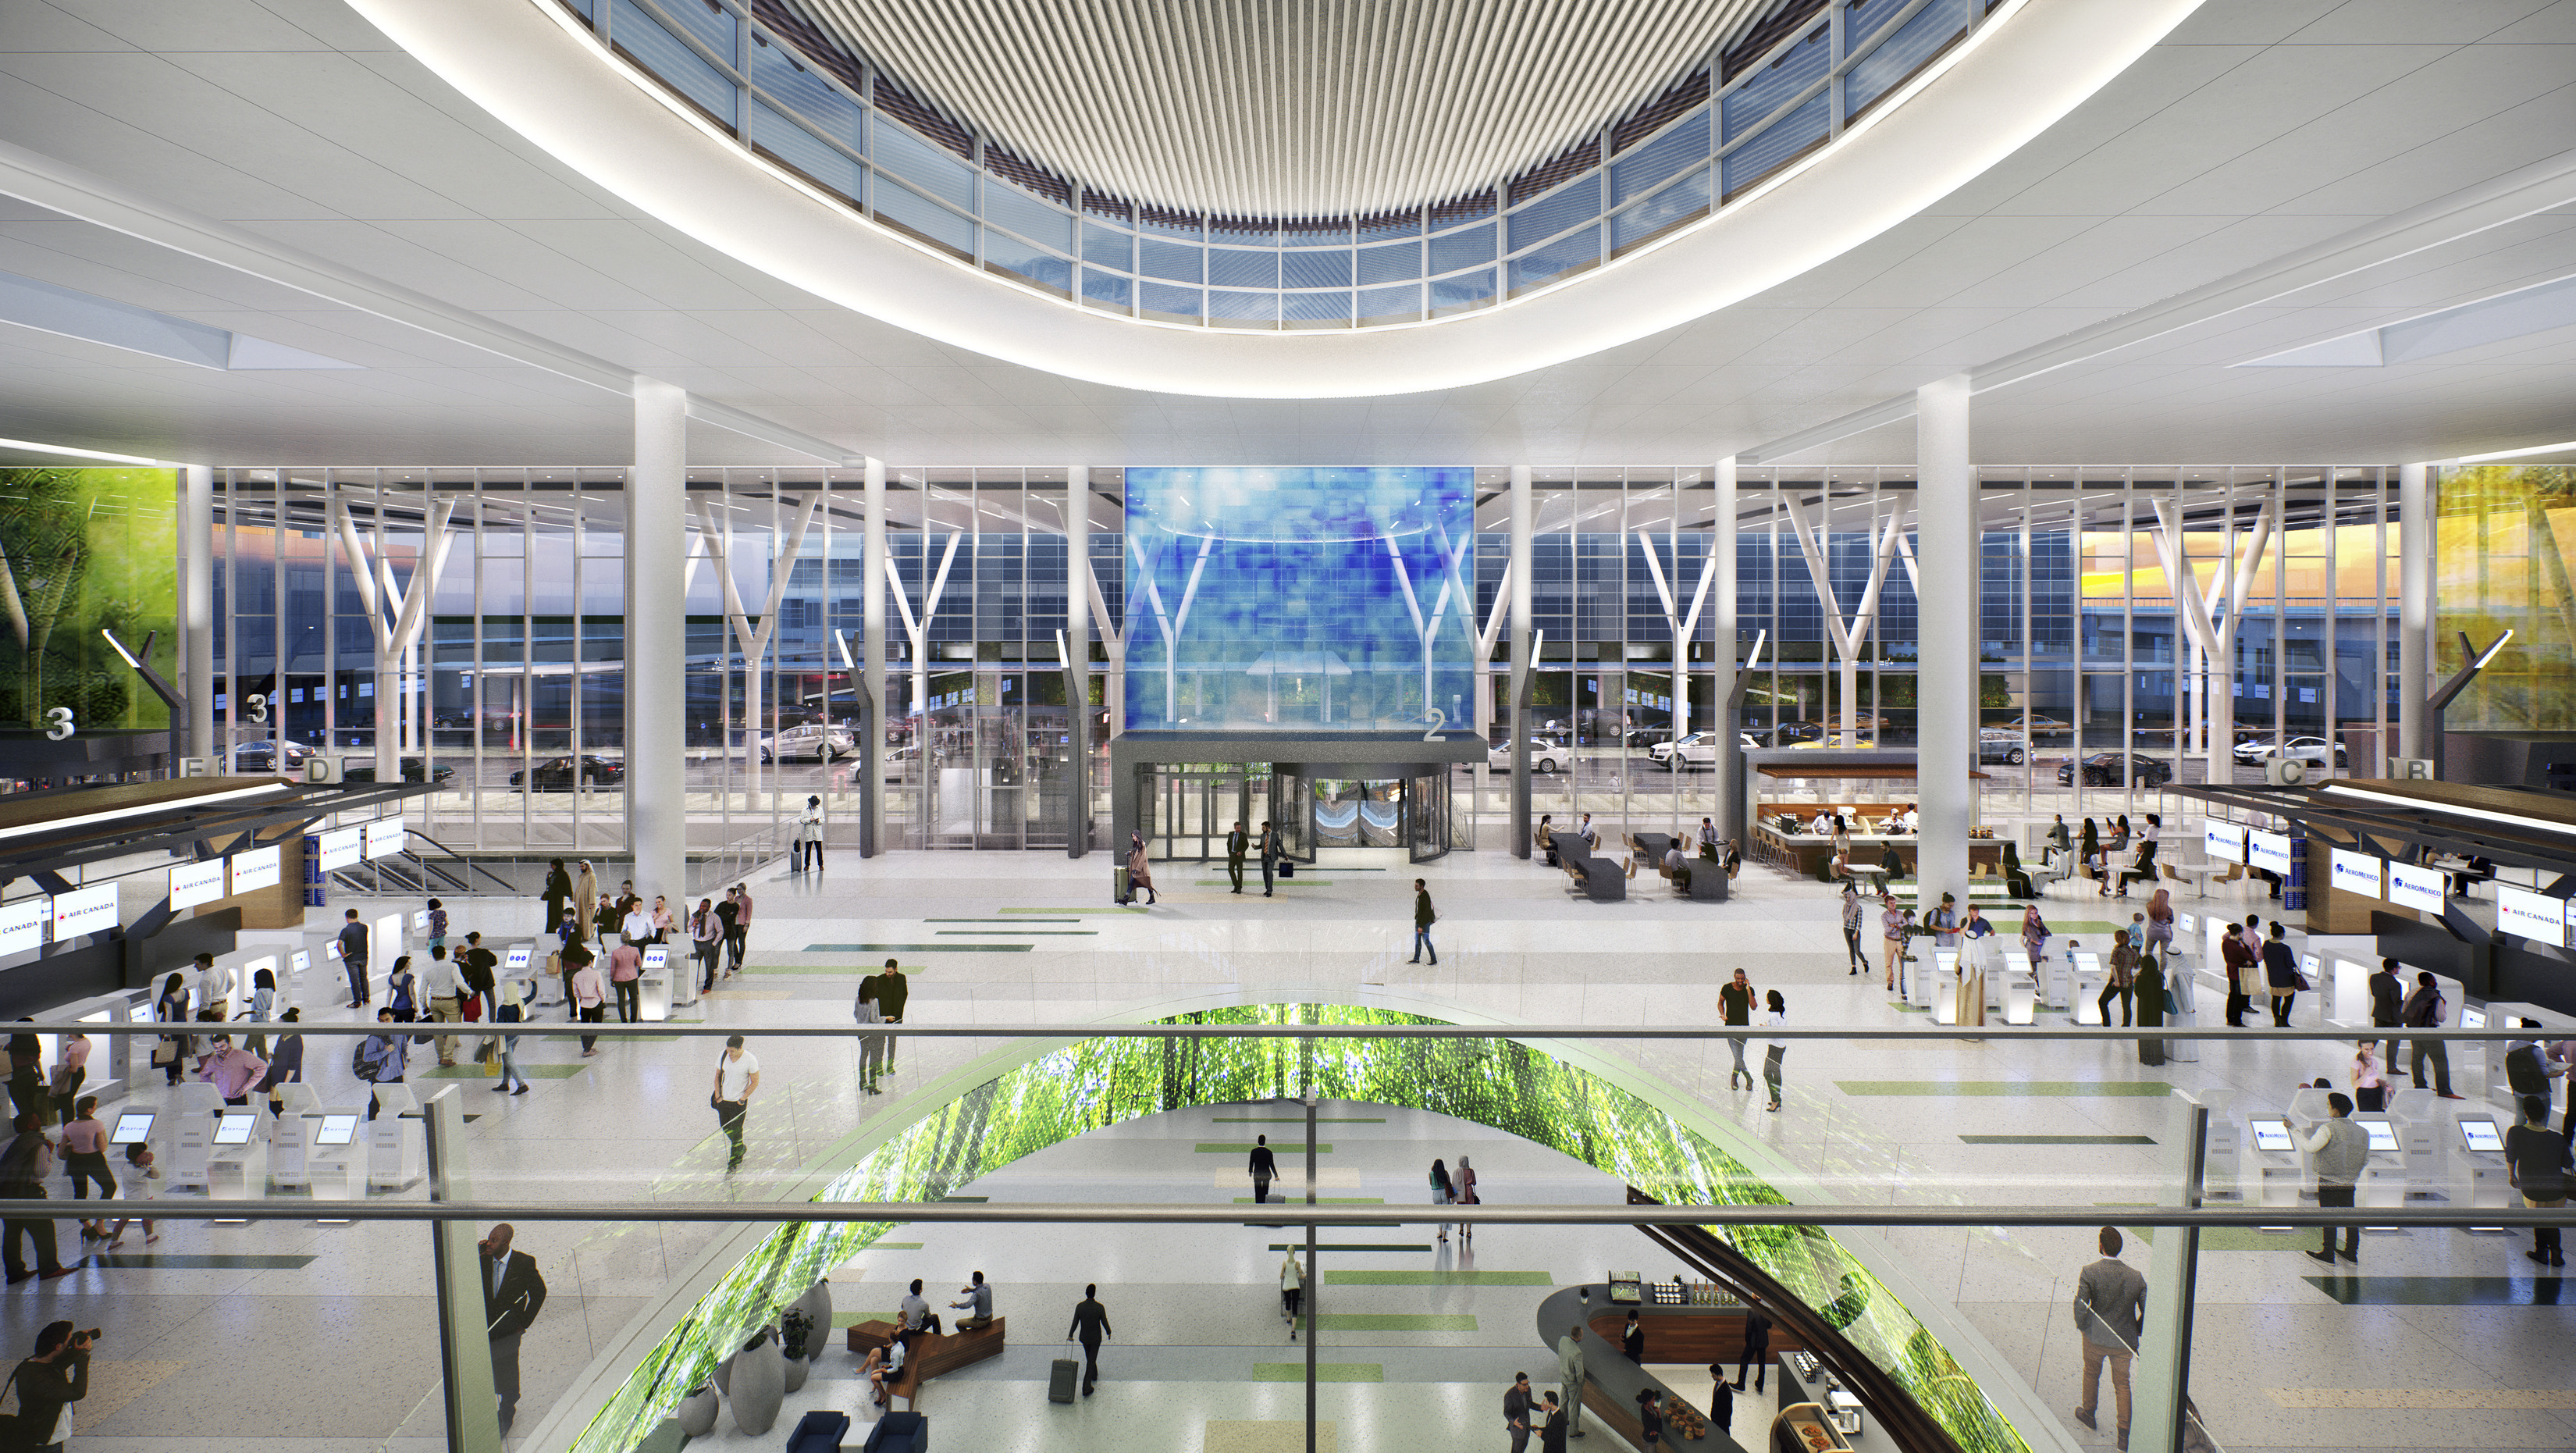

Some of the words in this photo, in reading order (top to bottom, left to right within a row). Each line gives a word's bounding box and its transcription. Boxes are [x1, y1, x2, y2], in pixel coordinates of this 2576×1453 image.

[246, 694, 268, 723] 3
[46, 707, 75, 741] 3
[1423, 708, 1446, 742] 2
[309, 760, 329, 782] D
[2280, 760, 2302, 785] C
[2408, 761, 2427, 779] B
[338, 842, 358, 851] CANADA
[2215, 836, 2241, 848] AEROMEXICO
[2260, 847, 2289, 860] AEROMEXICO
[254, 863, 277, 871] CANADA
[2345, 867, 2379, 881] AEROMEXICO
[194, 877, 221, 886] CANADA
[2404, 882, 2442, 897] AEROMEXICO
[68, 910, 81, 918] AIR
[83, 902, 115, 914] CANADA
[2512, 909, 2526, 917] AIR
[2527, 913, 2560, 925] CANADA
[2, 921, 38, 935] CANADA
